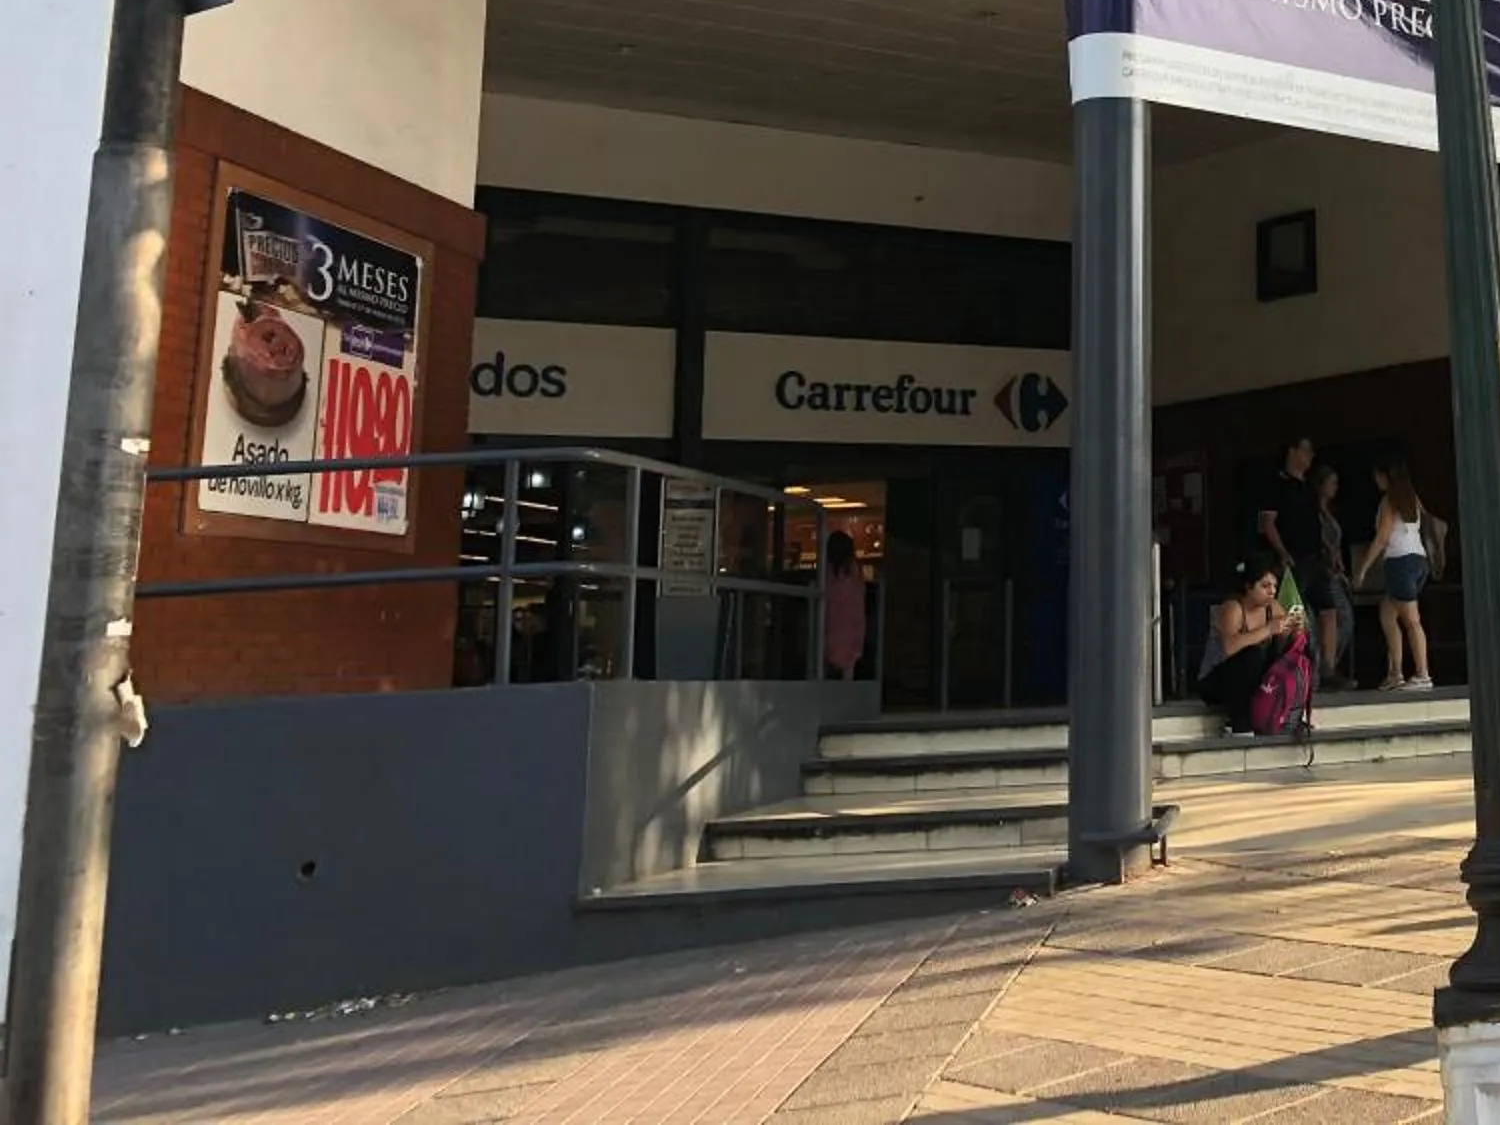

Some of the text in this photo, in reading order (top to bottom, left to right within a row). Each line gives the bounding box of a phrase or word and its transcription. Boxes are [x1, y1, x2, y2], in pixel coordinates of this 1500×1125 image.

[307, 242, 409, 302] 3 MESES
[471, 350, 567, 398] dos
[774, 370, 977, 416] Carrefour
